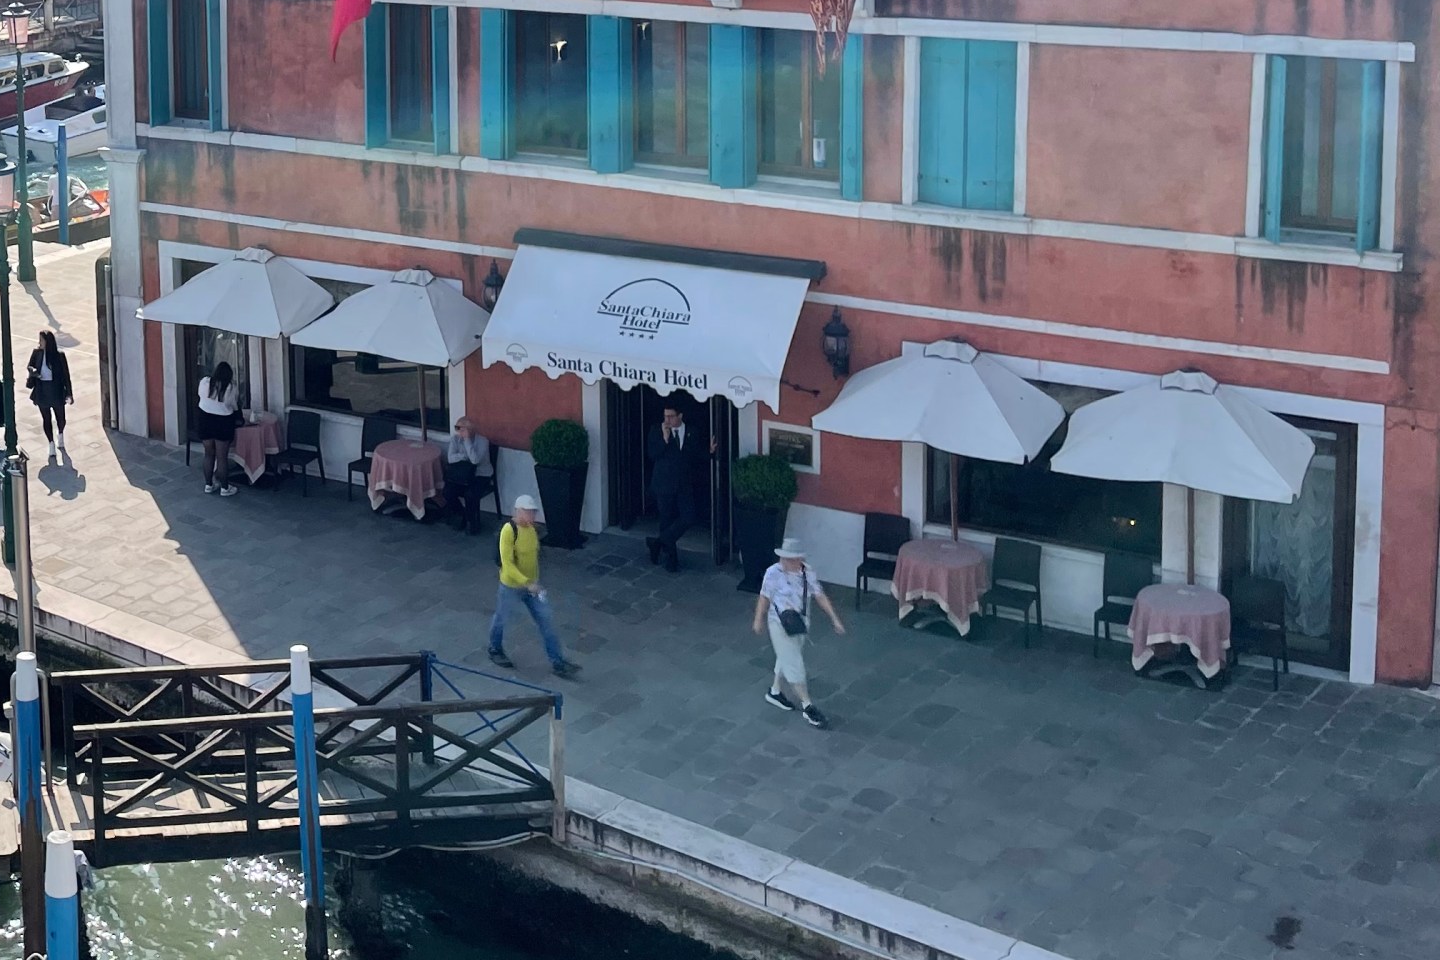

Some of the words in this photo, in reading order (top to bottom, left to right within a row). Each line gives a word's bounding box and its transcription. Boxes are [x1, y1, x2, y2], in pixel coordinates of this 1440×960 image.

[599, 299, 640, 316] Santa
[640, 305, 691, 322] Chiara
[547, 351, 593, 374] Santa
[599, 359, 657, 383] Chiara
[664, 368, 708, 390] Hôtel
